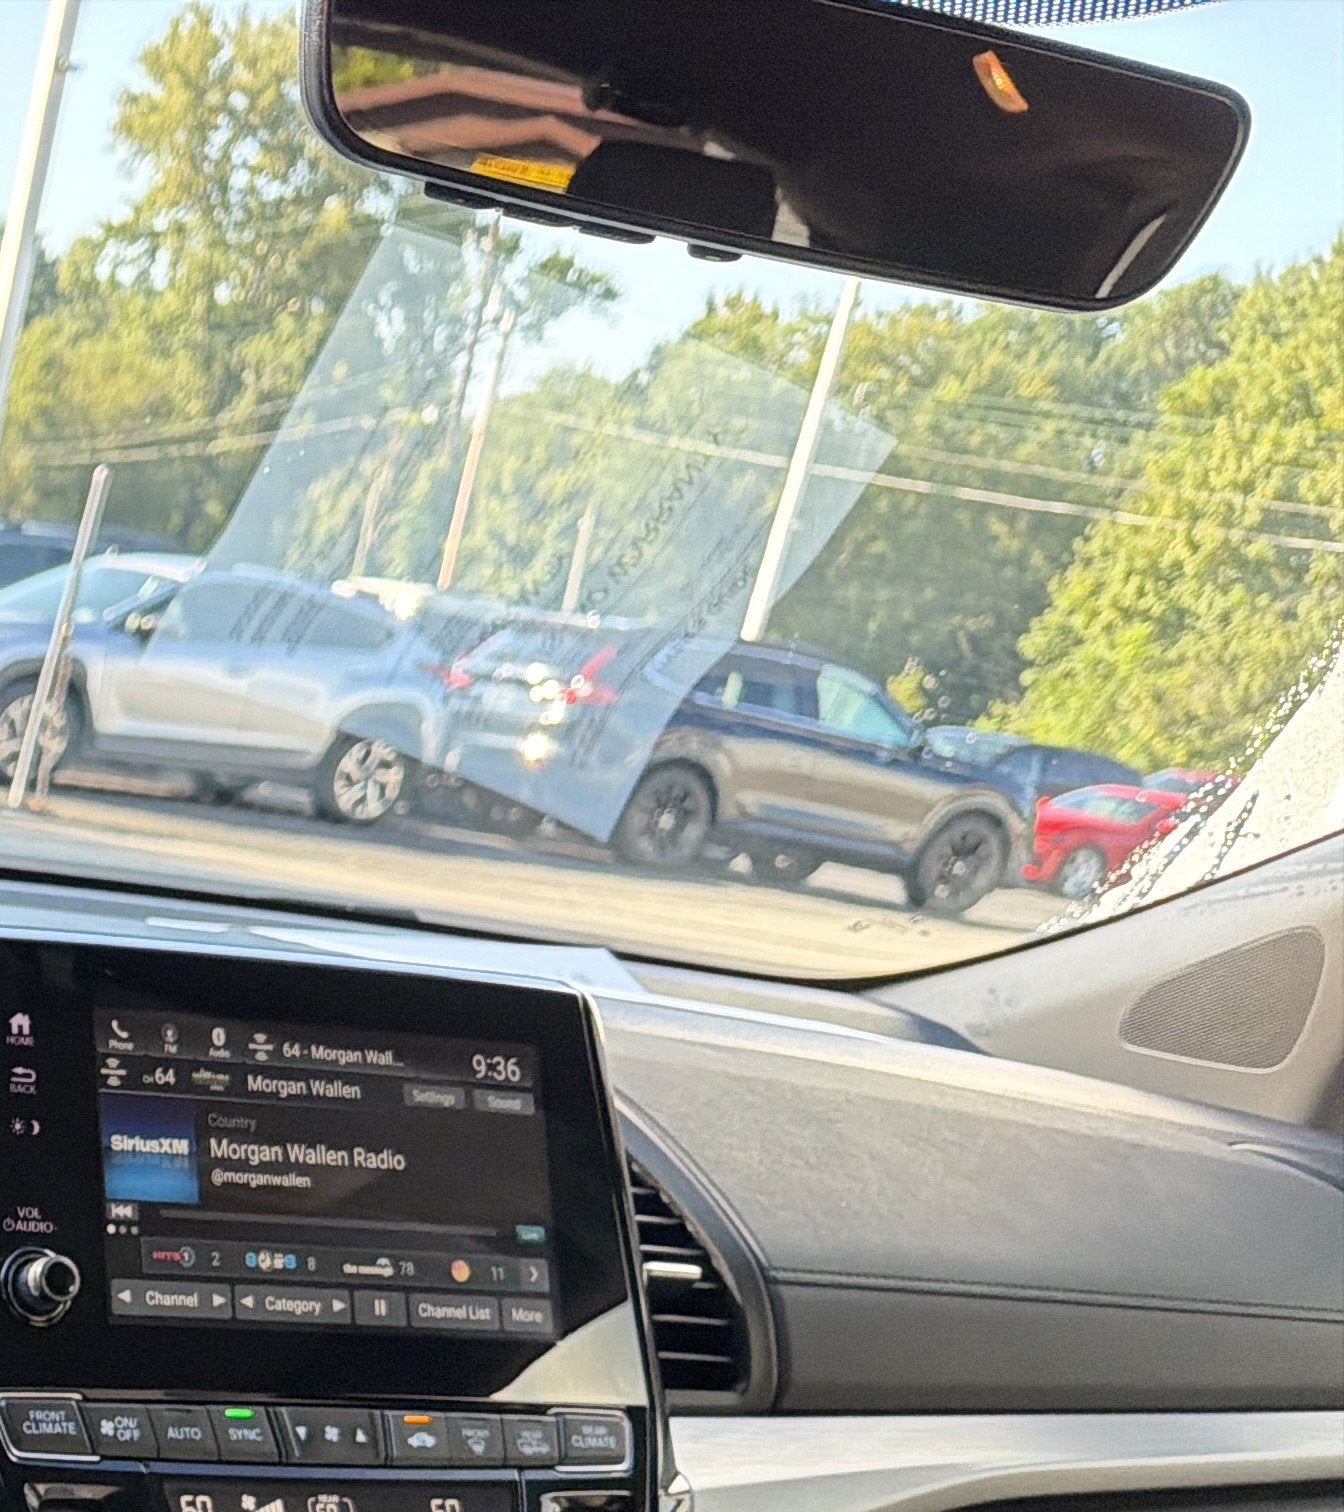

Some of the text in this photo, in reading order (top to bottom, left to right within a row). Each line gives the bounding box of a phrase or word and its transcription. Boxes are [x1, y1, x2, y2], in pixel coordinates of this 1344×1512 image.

[108, 1039, 134, 1050] Phone
[282, 1042, 300, 1058] 64
[311, 1044, 362, 1065] Morgan
[471, 1053, 521, 1082] 9:36
[155, 1067, 176, 1086] 64
[9, 1083, 37, 1095] BACK
[247, 1074, 306, 1098] Morgan
[310, 1078, 361, 1100] Wallen
[412, 1090, 456, 1107] Settings
[208, 1113, 257, 1133] Country
[110, 1134, 190, 1156] SiriusXM
[210, 1138, 406, 1171] Morgan Wallen Radio
[211, 1168, 312, 1188] @morganwallen
[16, 1206, 42, 1220] VOL
[15, 1219, 54, 1234] AUDIO
[211, 1251, 221, 1267] 2
[306, 1256, 316, 1272] 8
[398, 1261, 415, 1277] 78
[490, 1266, 505, 1282] 11
[145, 1290, 199, 1308] Channel
[264, 1295, 322, 1316] Category
[418, 1302, 492, 1321] Channel List
[511, 1307, 544, 1324] More
[29, 1409, 66, 1422] FRONT
[22, 1421, 77, 1436] CLIMATE
[116, 1428, 142, 1442] OFF
[167, 1427, 202, 1441] AUTO
[228, 1428, 263, 1442] SYNC
[571, 1434, 617, 1449] CLIMATE
